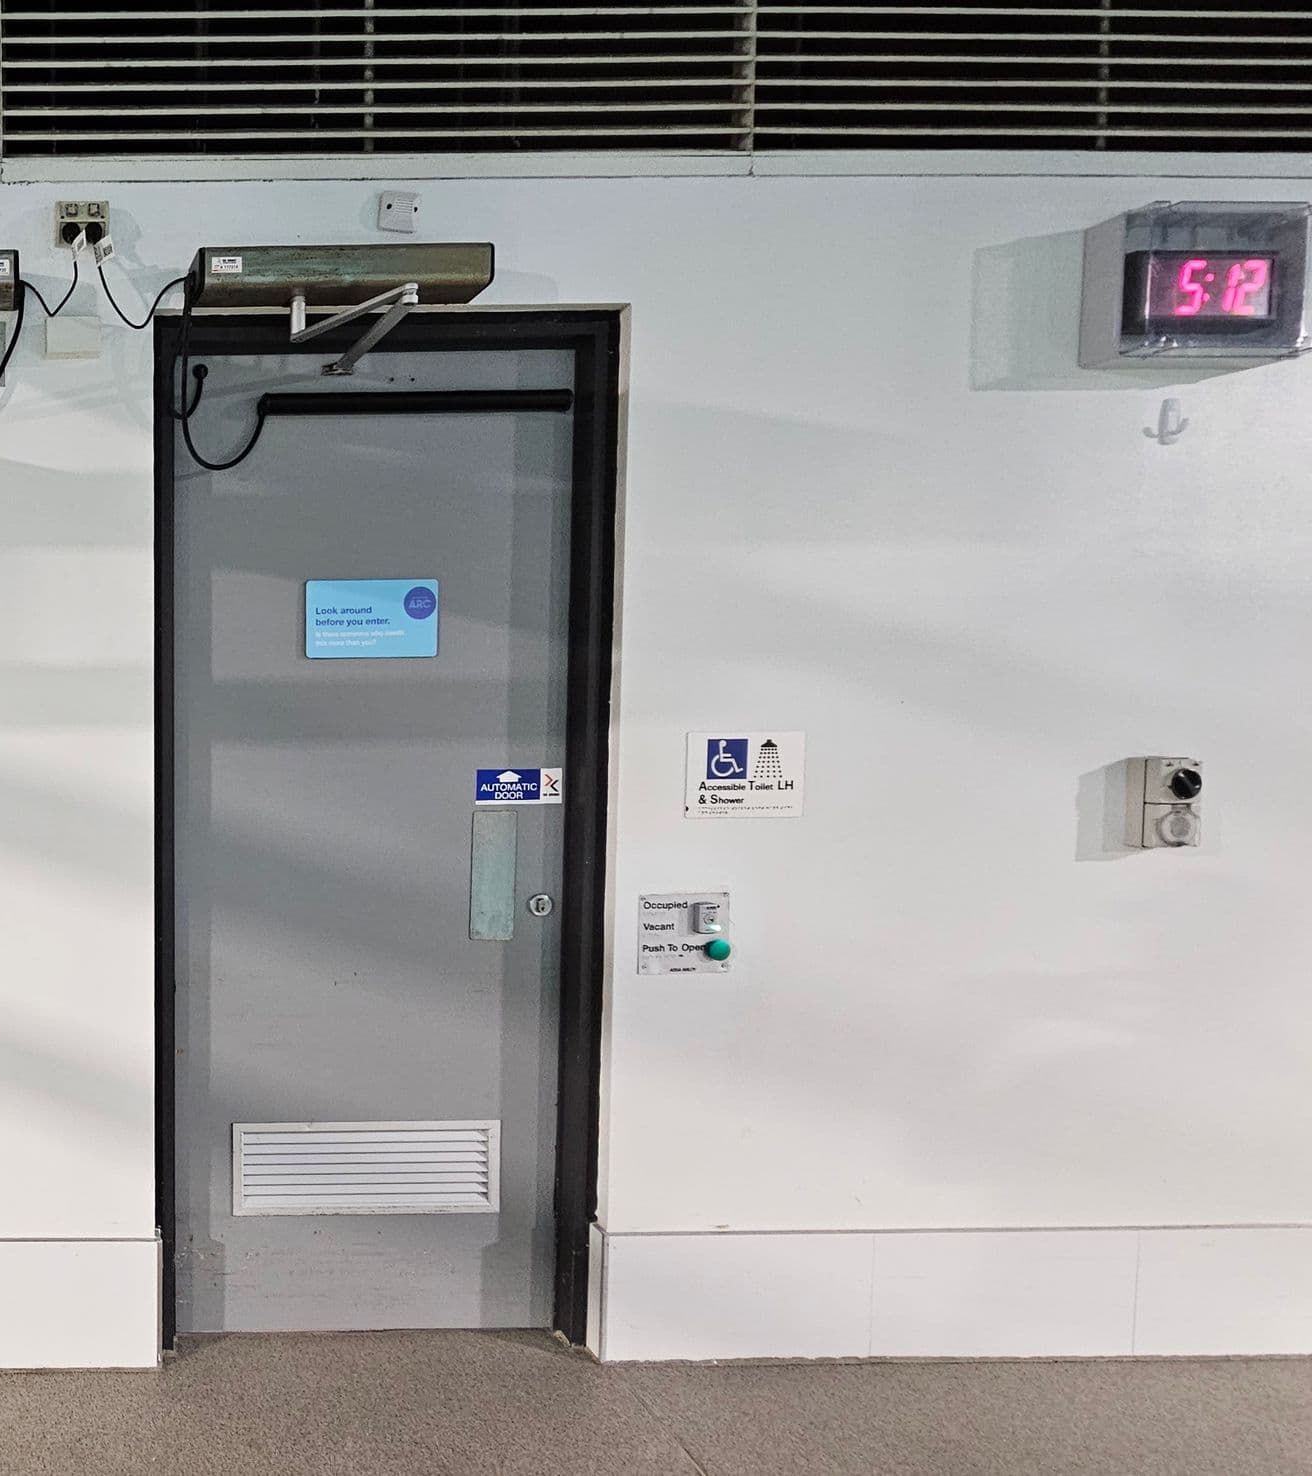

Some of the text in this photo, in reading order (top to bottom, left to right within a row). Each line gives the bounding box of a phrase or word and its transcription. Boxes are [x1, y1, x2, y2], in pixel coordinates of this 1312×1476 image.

[1174, 257, 1268, 316] 5:12
[408, 600, 432, 609] ARC
[315, 606, 373, 615] Look around
[315, 618, 345, 626] before
[346, 619, 363, 628] you
[480, 783, 538, 792] AUTOMATIC
[698, 780, 794, 791] Accessible Toilet LH
[494, 791, 524, 800] DOOR
[698, 794, 745, 804] & Shower
[643, 901, 688, 911] Occupied
[643, 923, 675, 931] Vacant
[642, 944, 665, 952] Push
[667, 944, 678, 952] To
